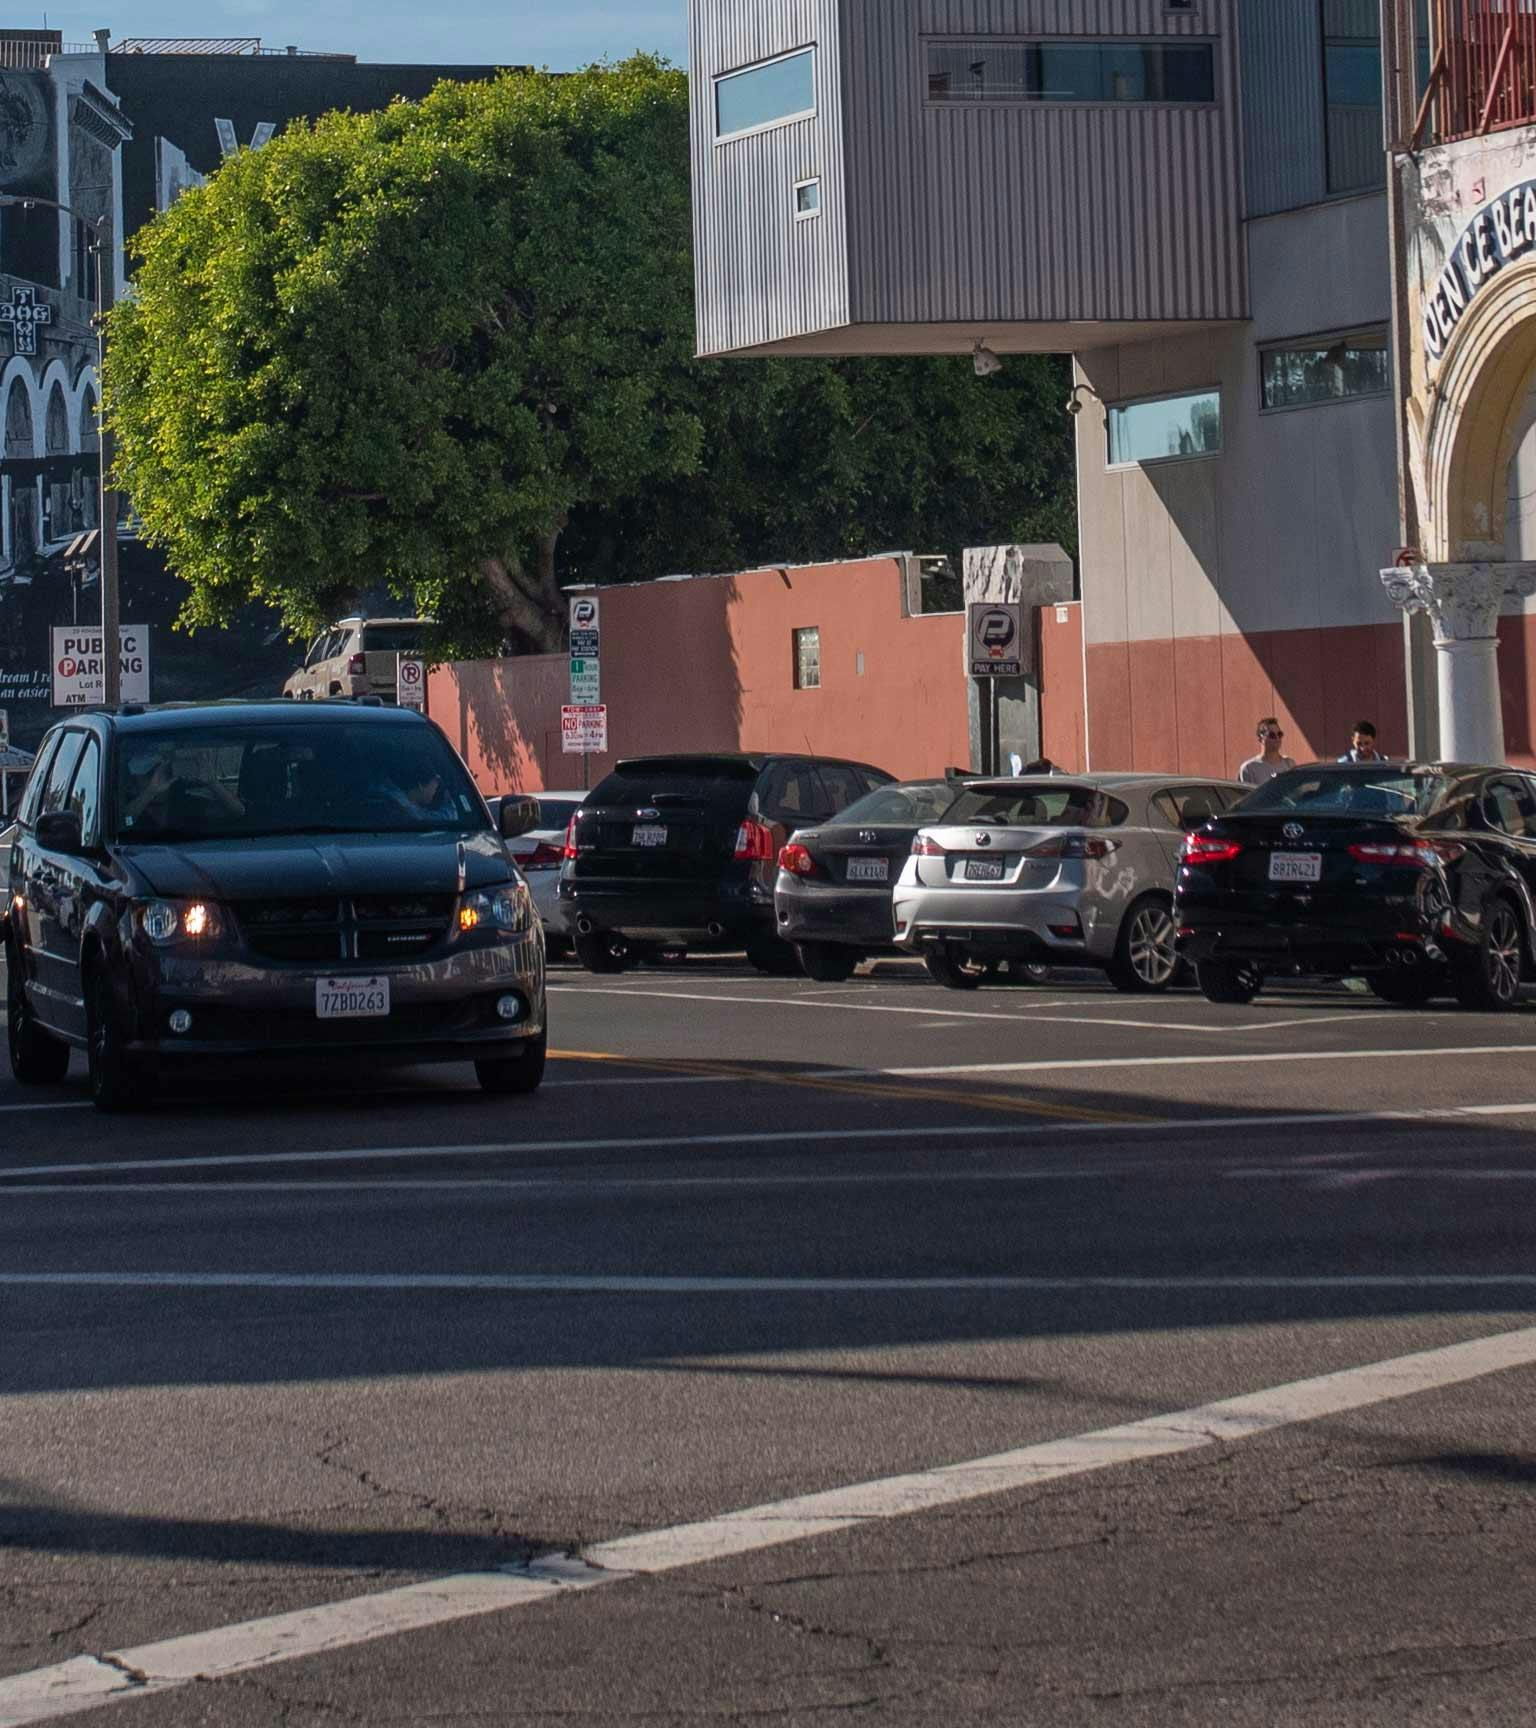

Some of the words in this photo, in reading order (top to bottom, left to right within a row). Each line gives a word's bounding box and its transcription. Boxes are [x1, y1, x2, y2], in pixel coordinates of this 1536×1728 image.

[64, 637, 137, 655] PUBIC
[79, 680, 94, 689] Lot
[0, 689, 15, 698] an
[18, 686, 50, 699] easier
[65, 694, 86, 703] ATM
[564, 718, 577, 729] NO
[578, 720, 604, 729] PARKING
[321, 992, 385, 1012] 7ZBD263
